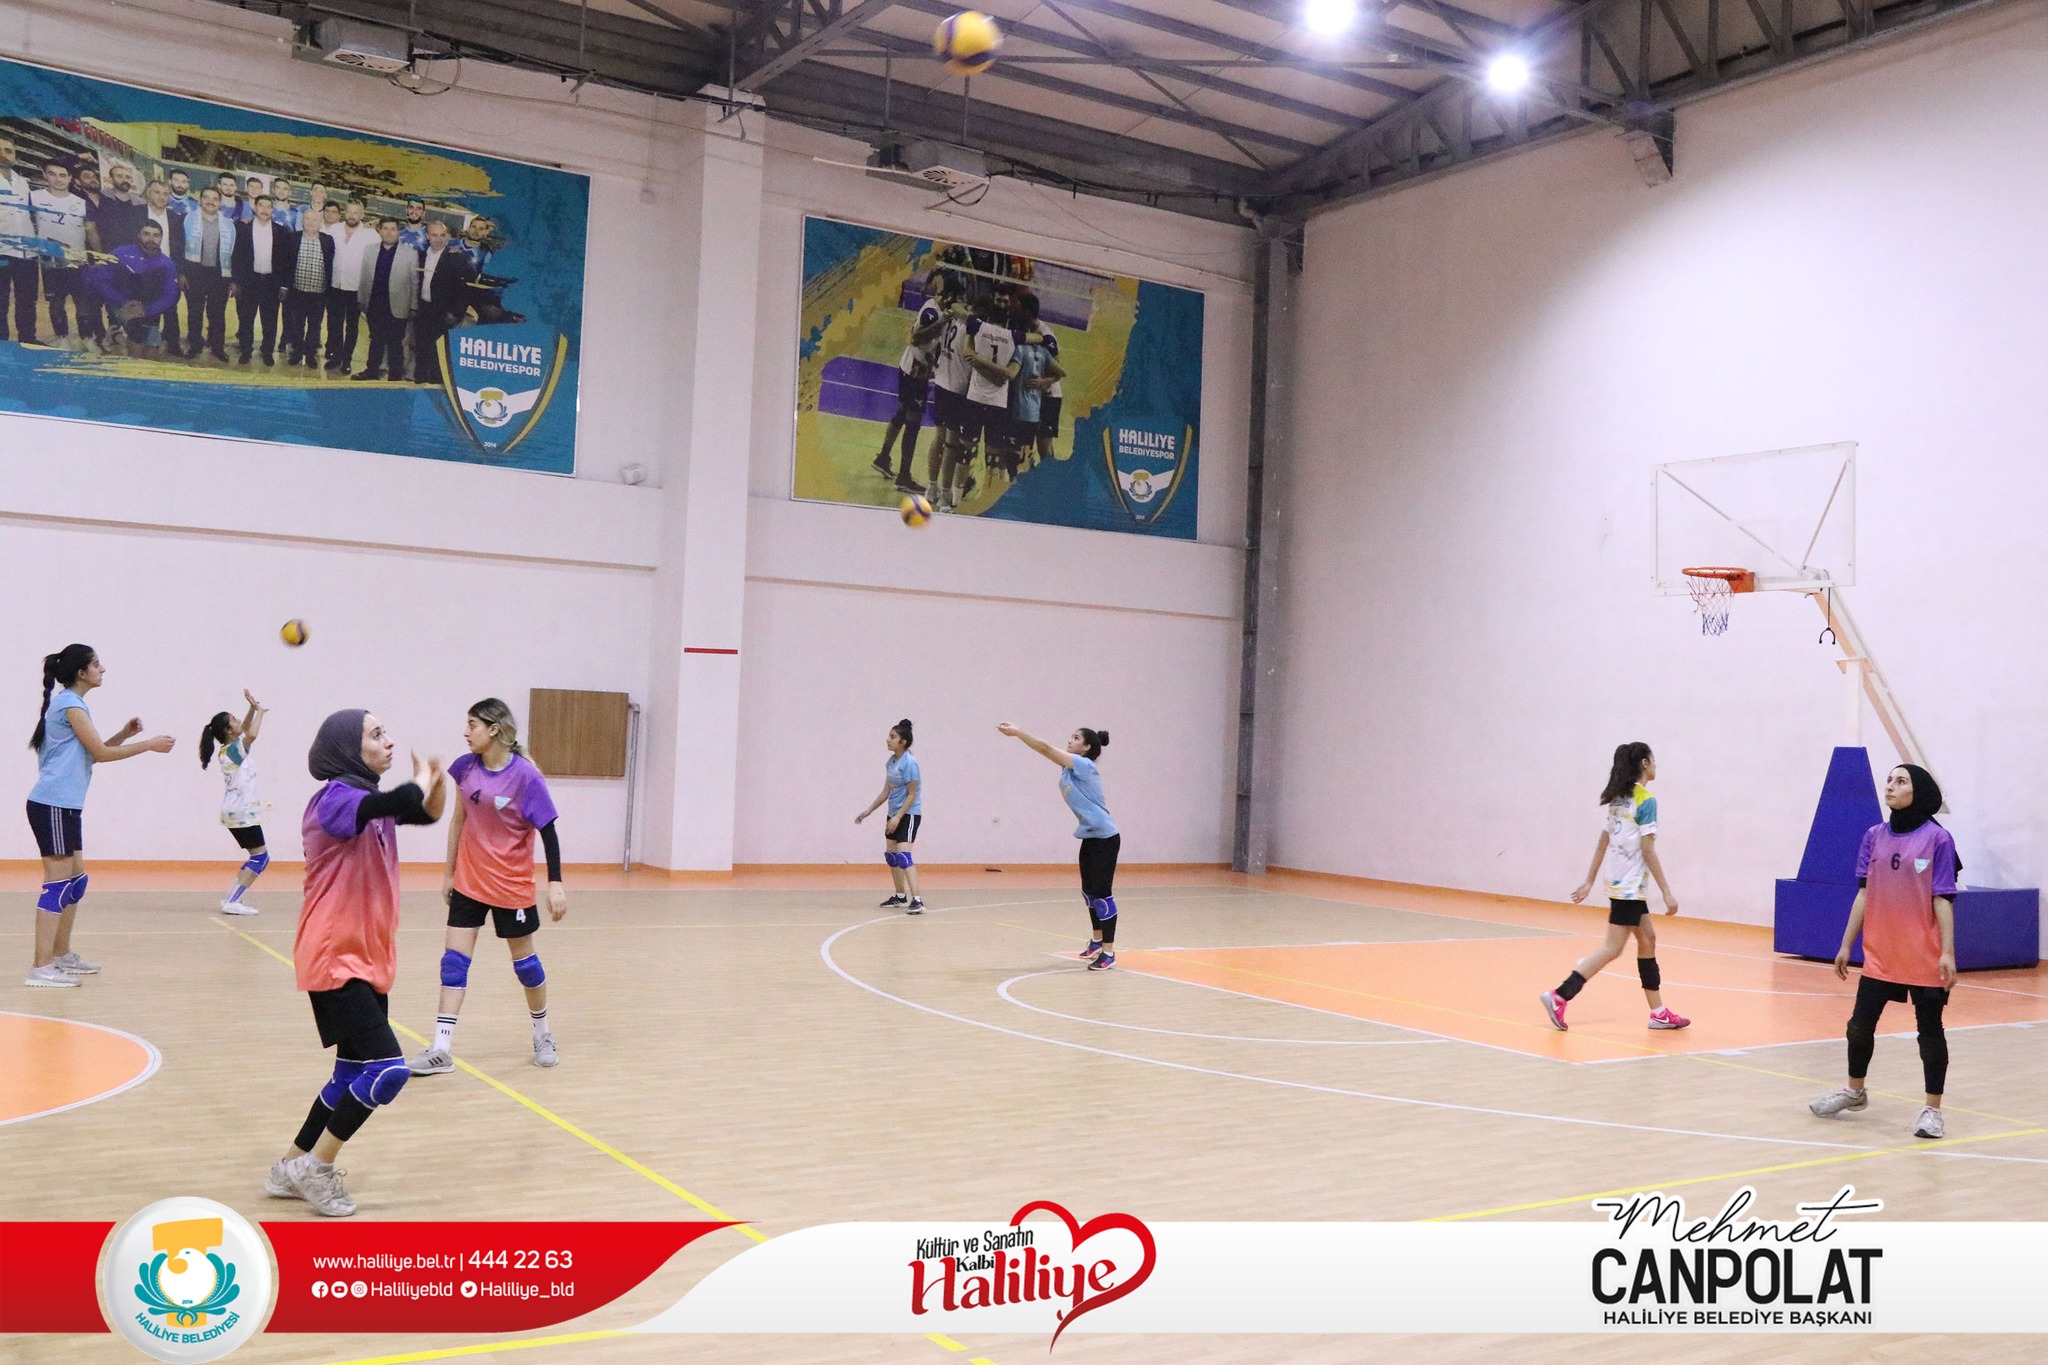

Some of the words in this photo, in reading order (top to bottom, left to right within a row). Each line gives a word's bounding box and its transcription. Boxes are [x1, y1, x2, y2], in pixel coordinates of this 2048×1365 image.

[460, 336, 541, 365] HALİLİYE
[459, 356, 541, 377] BELEDİYESPOR
[1119, 428, 1175, 450] HALİLİYE
[1118, 445, 1175, 460] BELEDİYESPOR
[469, 789, 482, 805] 4
[1890, 852, 1901, 871] 6
[515, 908, 526, 924] 4
